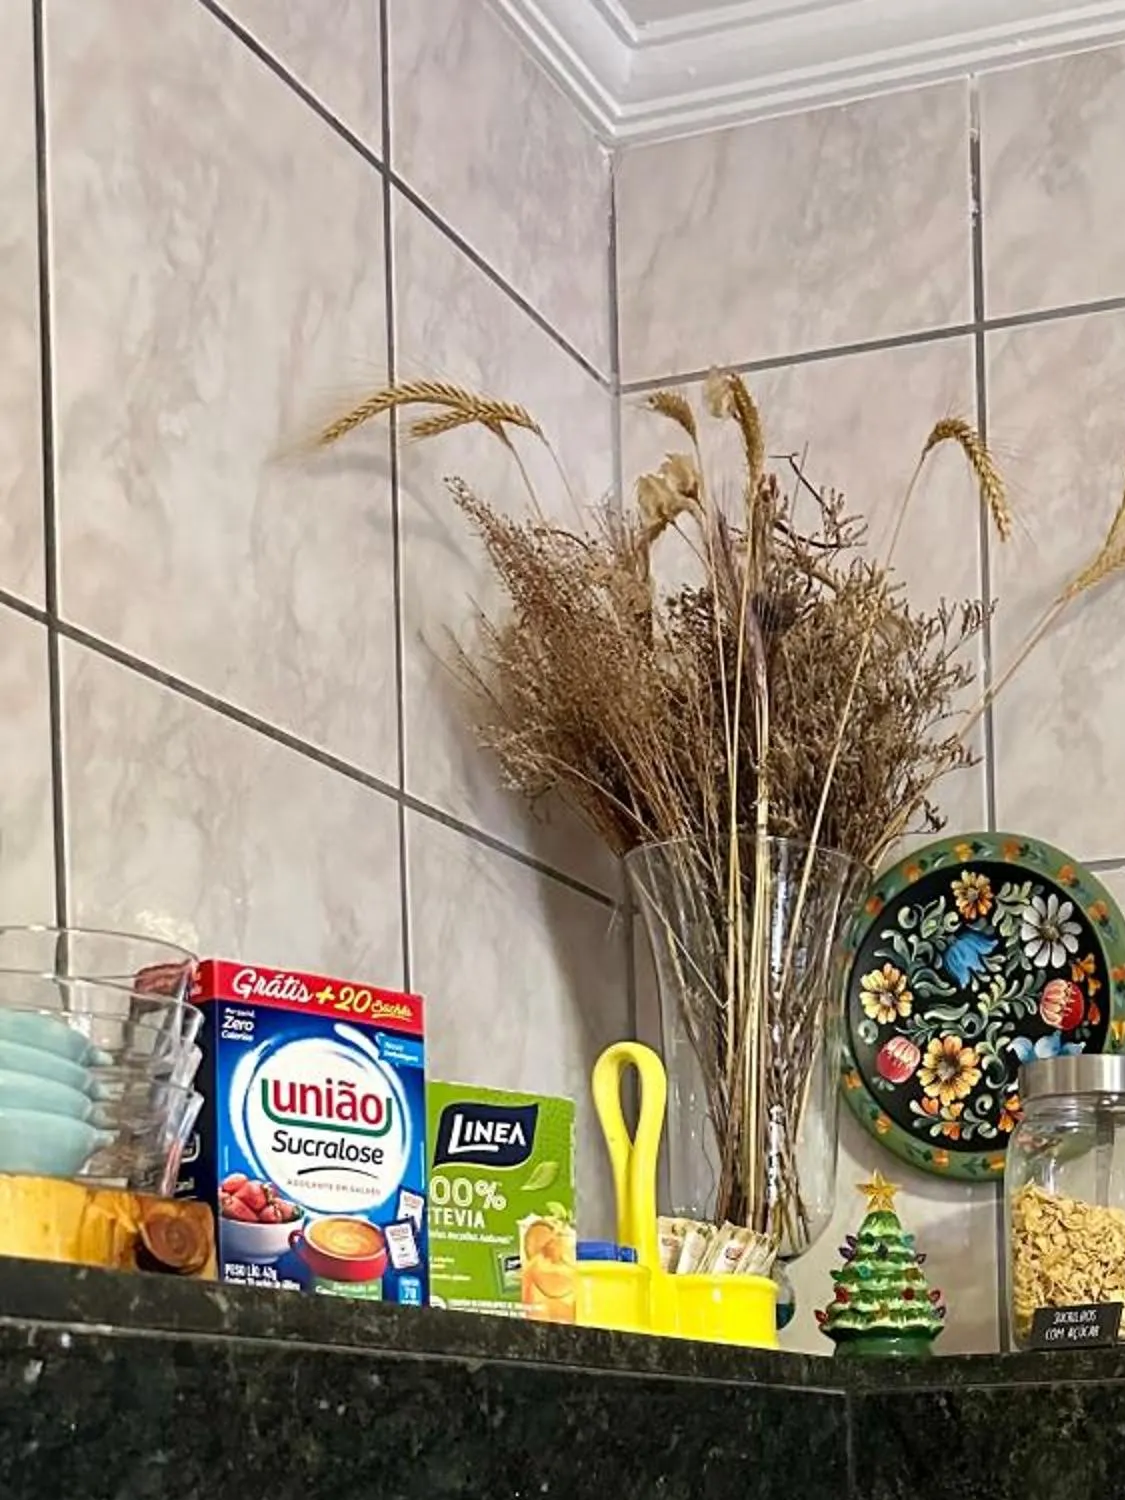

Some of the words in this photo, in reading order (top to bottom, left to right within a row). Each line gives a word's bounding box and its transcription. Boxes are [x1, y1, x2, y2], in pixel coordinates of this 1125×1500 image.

[232, 968, 312, 1004] Grátis
[333, 986, 372, 1014] 20
[222, 1015, 254, 1031] Zero
[273, 1077, 383, 1125] união
[271, 1129, 384, 1165] Sucralose
[448, 1113, 527, 1154] LINEA
[430, 1175, 508, 1211] 00%
[430, 1207, 486, 1229] TEVIA
[1045, 1328, 1065, 1341] COM
